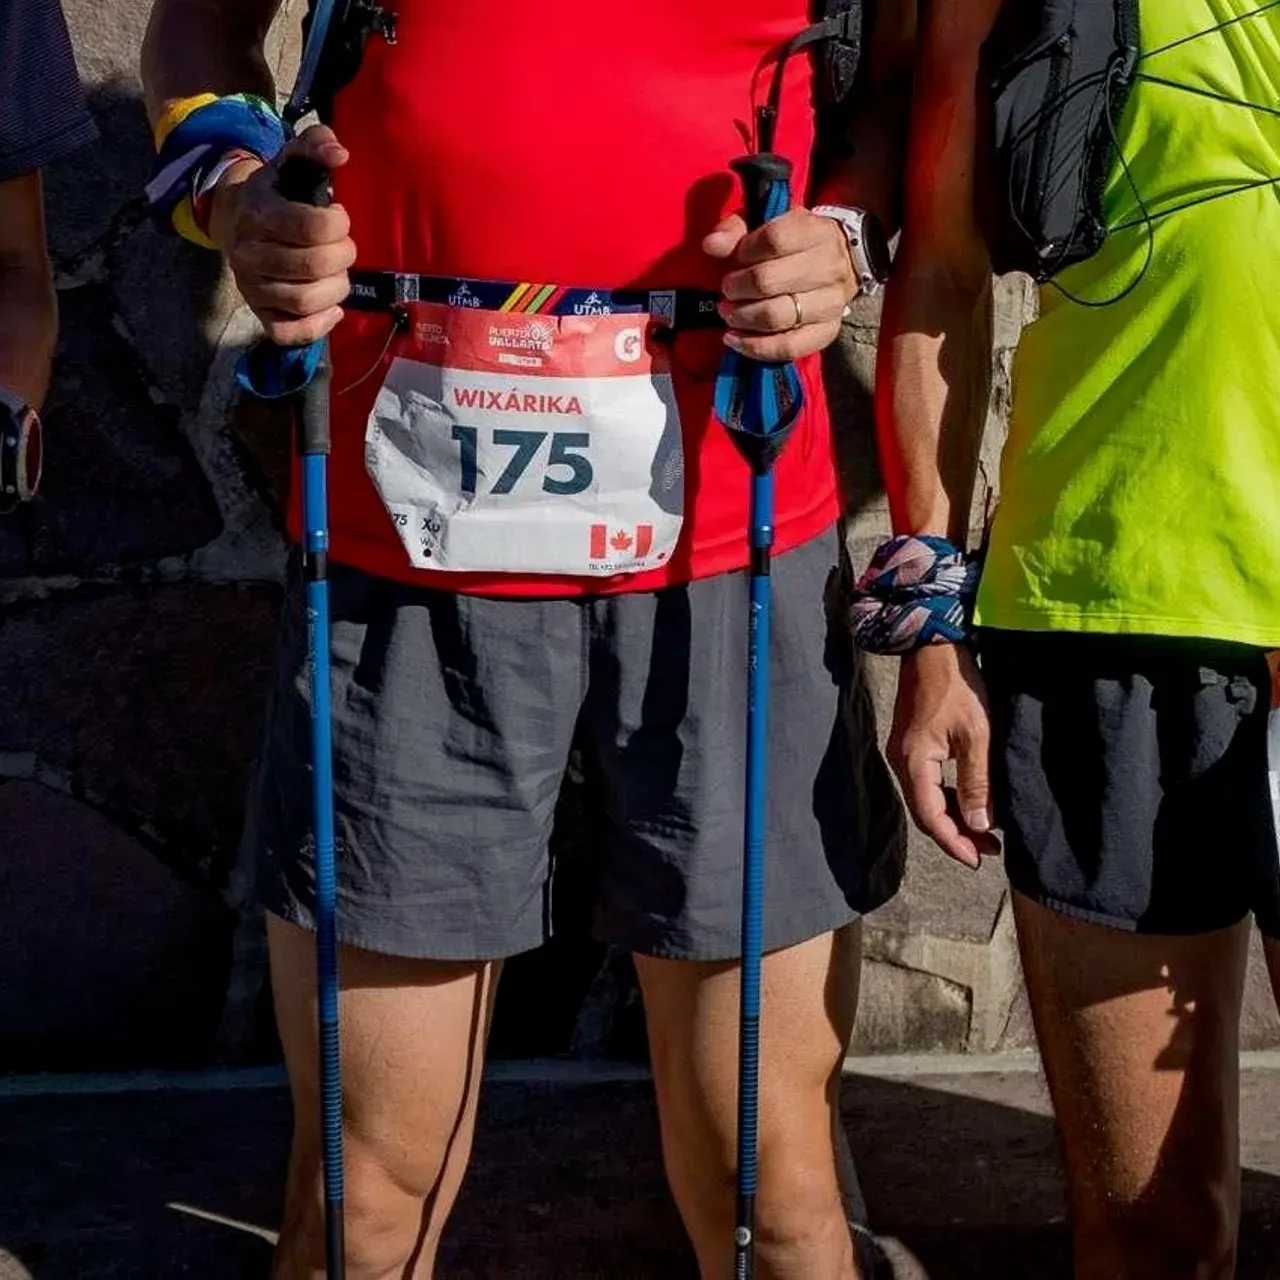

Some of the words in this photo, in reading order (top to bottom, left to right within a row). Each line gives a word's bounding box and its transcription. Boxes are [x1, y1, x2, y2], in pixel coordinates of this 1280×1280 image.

[448, 294, 480, 308] UTMB
[574, 304, 611, 316] UTMB
[453, 387, 582, 415] WIXÁRIKA
[451, 425, 593, 495] 175
[393, 513, 408, 526] 75
